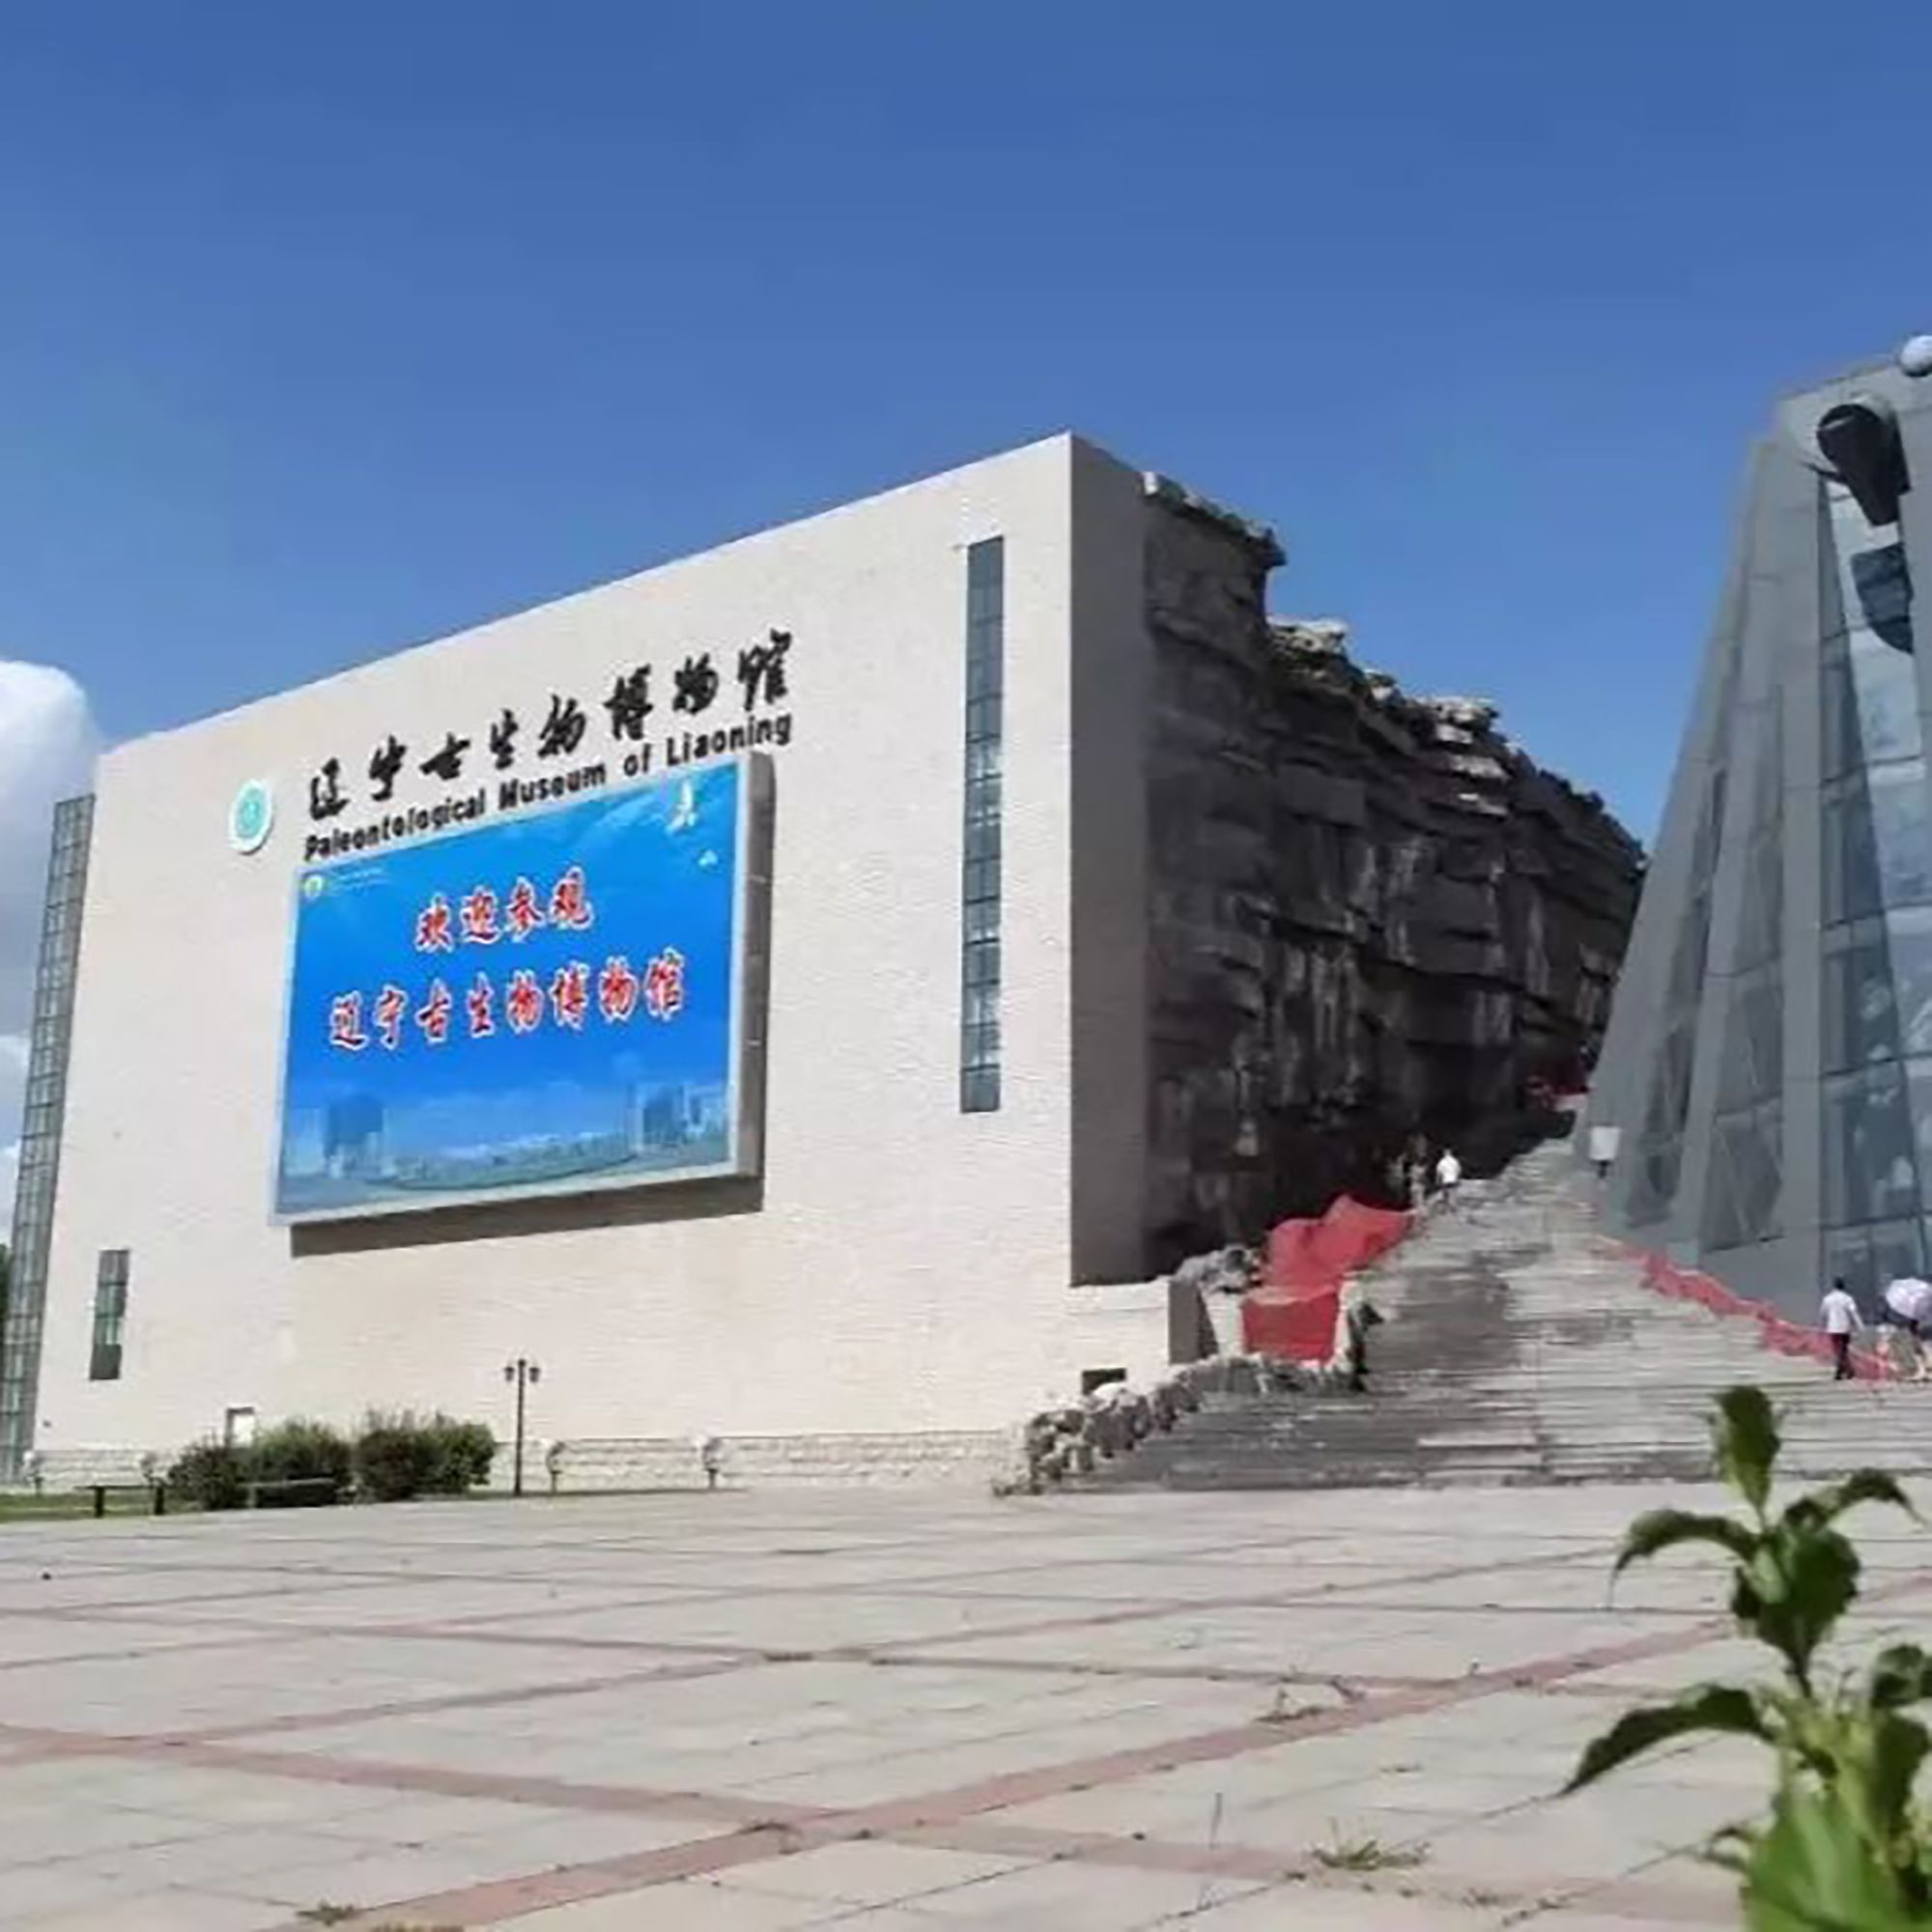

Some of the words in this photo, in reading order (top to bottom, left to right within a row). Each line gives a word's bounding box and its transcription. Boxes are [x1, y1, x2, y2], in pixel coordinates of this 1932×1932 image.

[303, 788, 485, 862] Paleontological
[497, 763, 607, 810] Museum
[622, 744, 651, 778] of
[667, 713, 793, 767] Liaoning
[309, 629, 791, 820] 辽宁古生物博物馆
[415, 866, 593, 952] 欢迎参观
[329, 946, 685, 1050] 辽宁古生物博物馆
